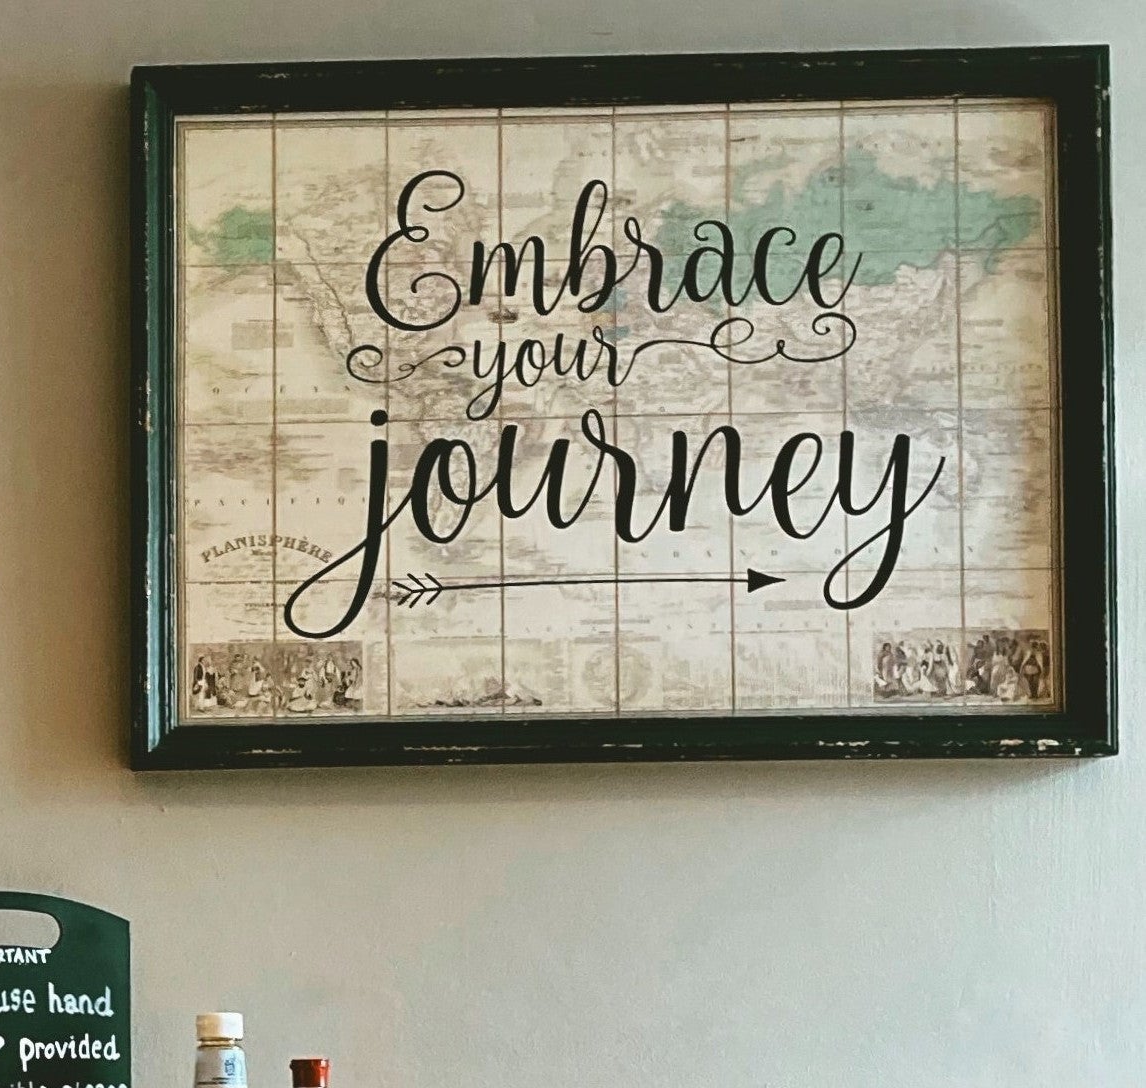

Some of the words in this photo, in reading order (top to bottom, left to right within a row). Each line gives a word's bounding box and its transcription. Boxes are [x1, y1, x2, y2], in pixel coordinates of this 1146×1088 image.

[365, 170, 862, 332] Embrace
[284, 410, 945, 640] journey
[48, 981, 114, 1017] hand
[19, 1033, 121, 1072] provided
